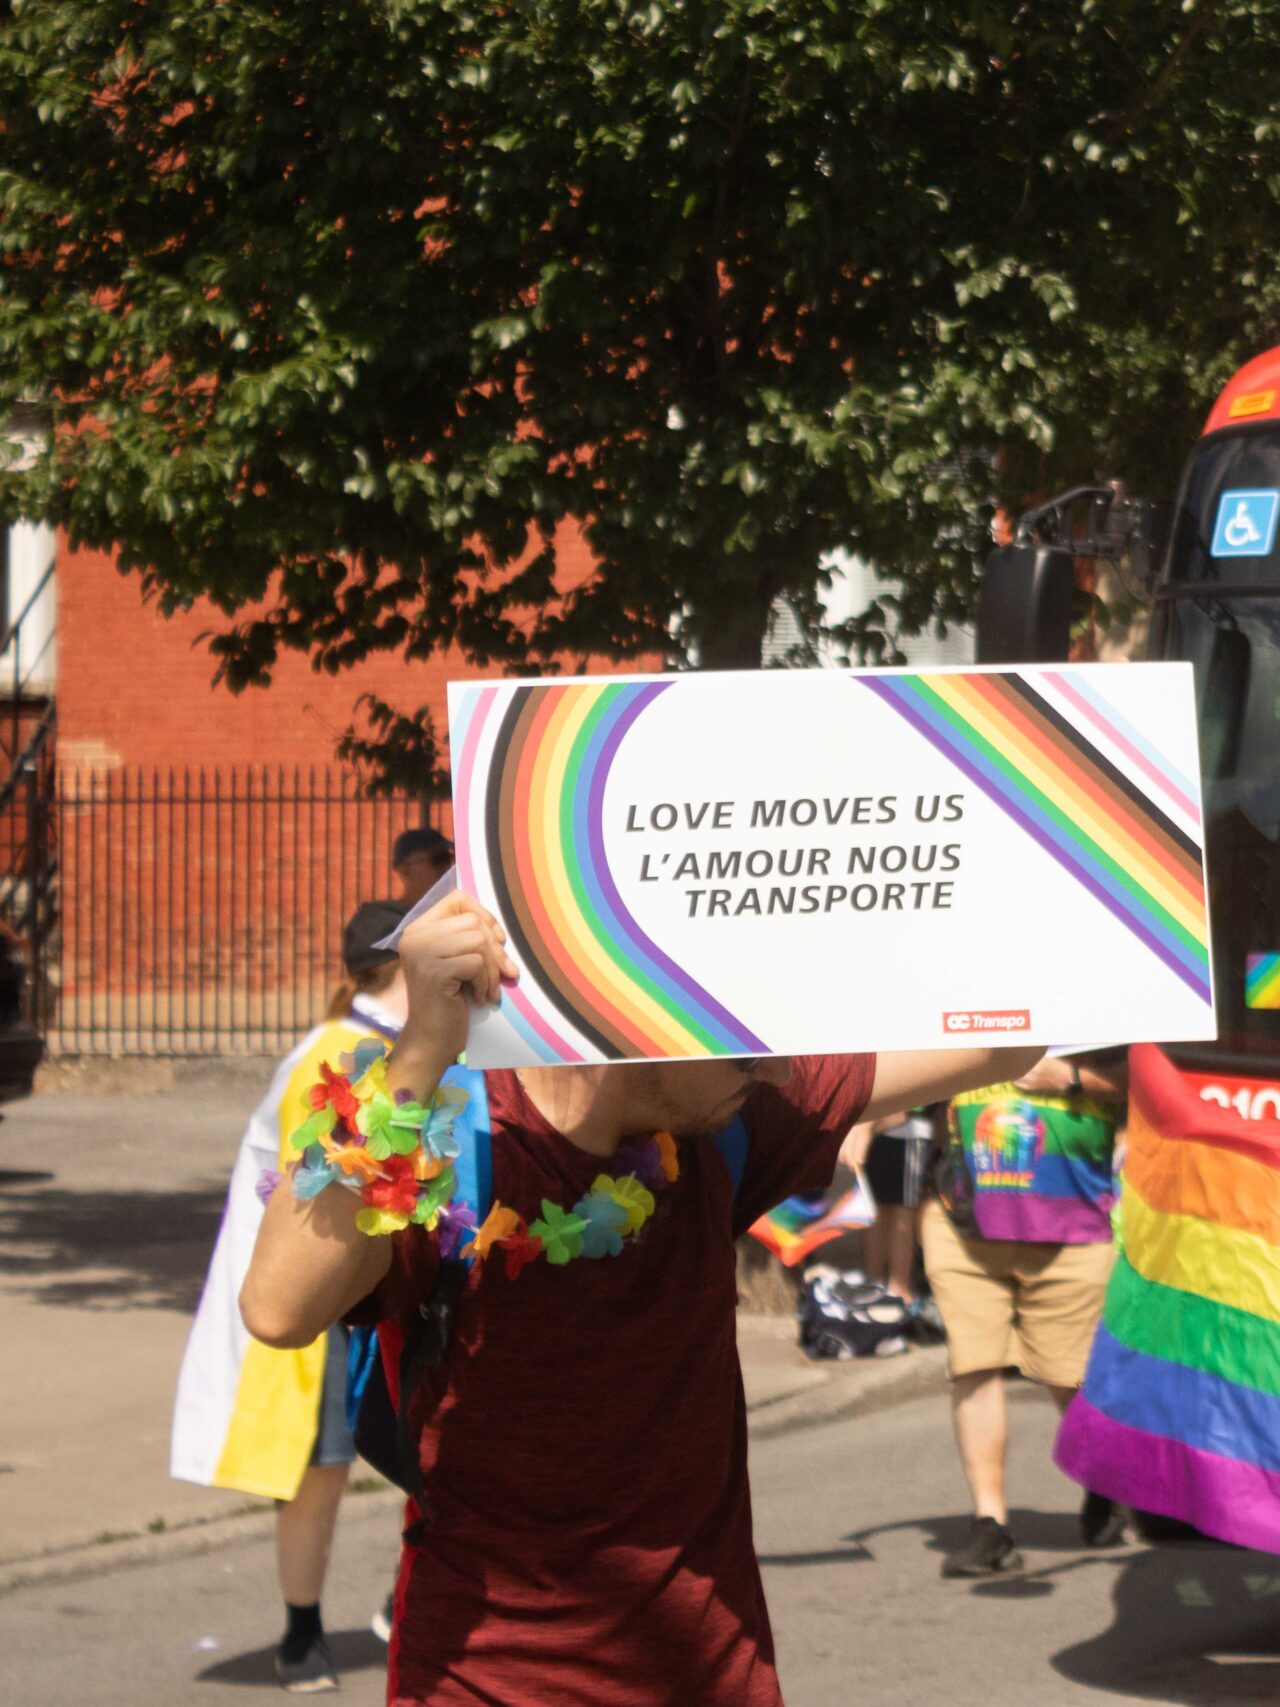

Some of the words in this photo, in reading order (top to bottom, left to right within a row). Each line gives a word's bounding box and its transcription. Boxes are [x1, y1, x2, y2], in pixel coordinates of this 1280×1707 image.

[625, 800, 735, 832] LOVE
[749, 796, 898, 829] MOVES
[914, 794, 965, 823] US
[639, 847, 831, 882] L'AMOUR
[846, 843, 962, 875] NOUS
[684, 881, 955, 918] TRANSPORTE
[946, 1013, 971, 1030] OC
[971, 1015, 1026, 1031] Transpo
